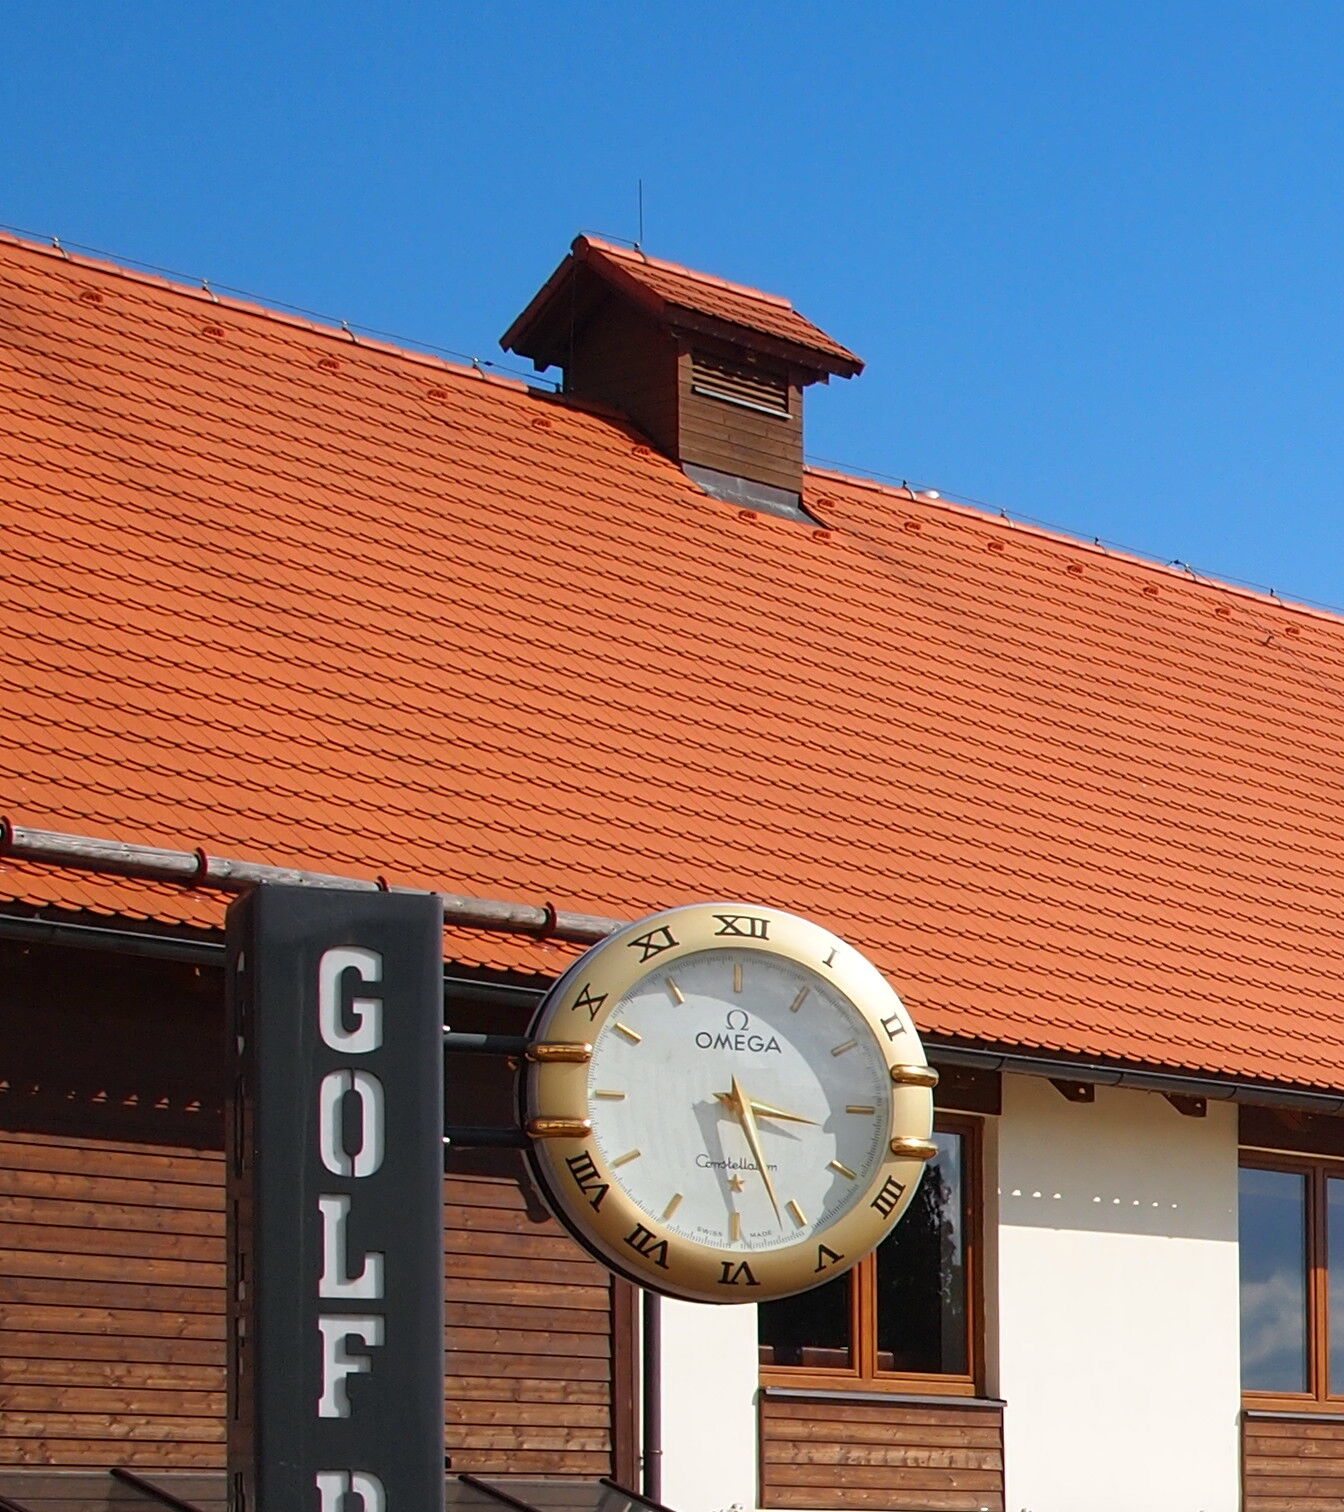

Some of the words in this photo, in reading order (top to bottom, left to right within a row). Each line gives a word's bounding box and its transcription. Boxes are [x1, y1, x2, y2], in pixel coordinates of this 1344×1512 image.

[712, 914, 771, 940] XII
[627, 925, 680, 963] XI
[571, 982, 609, 1021] X
[695, 1031, 782, 1054] OMEGA
[318, 945, 386, 1418] GOLF
[697, 1226, 723, 1237] SWISS
[750, 1229, 773, 1238] MADE
